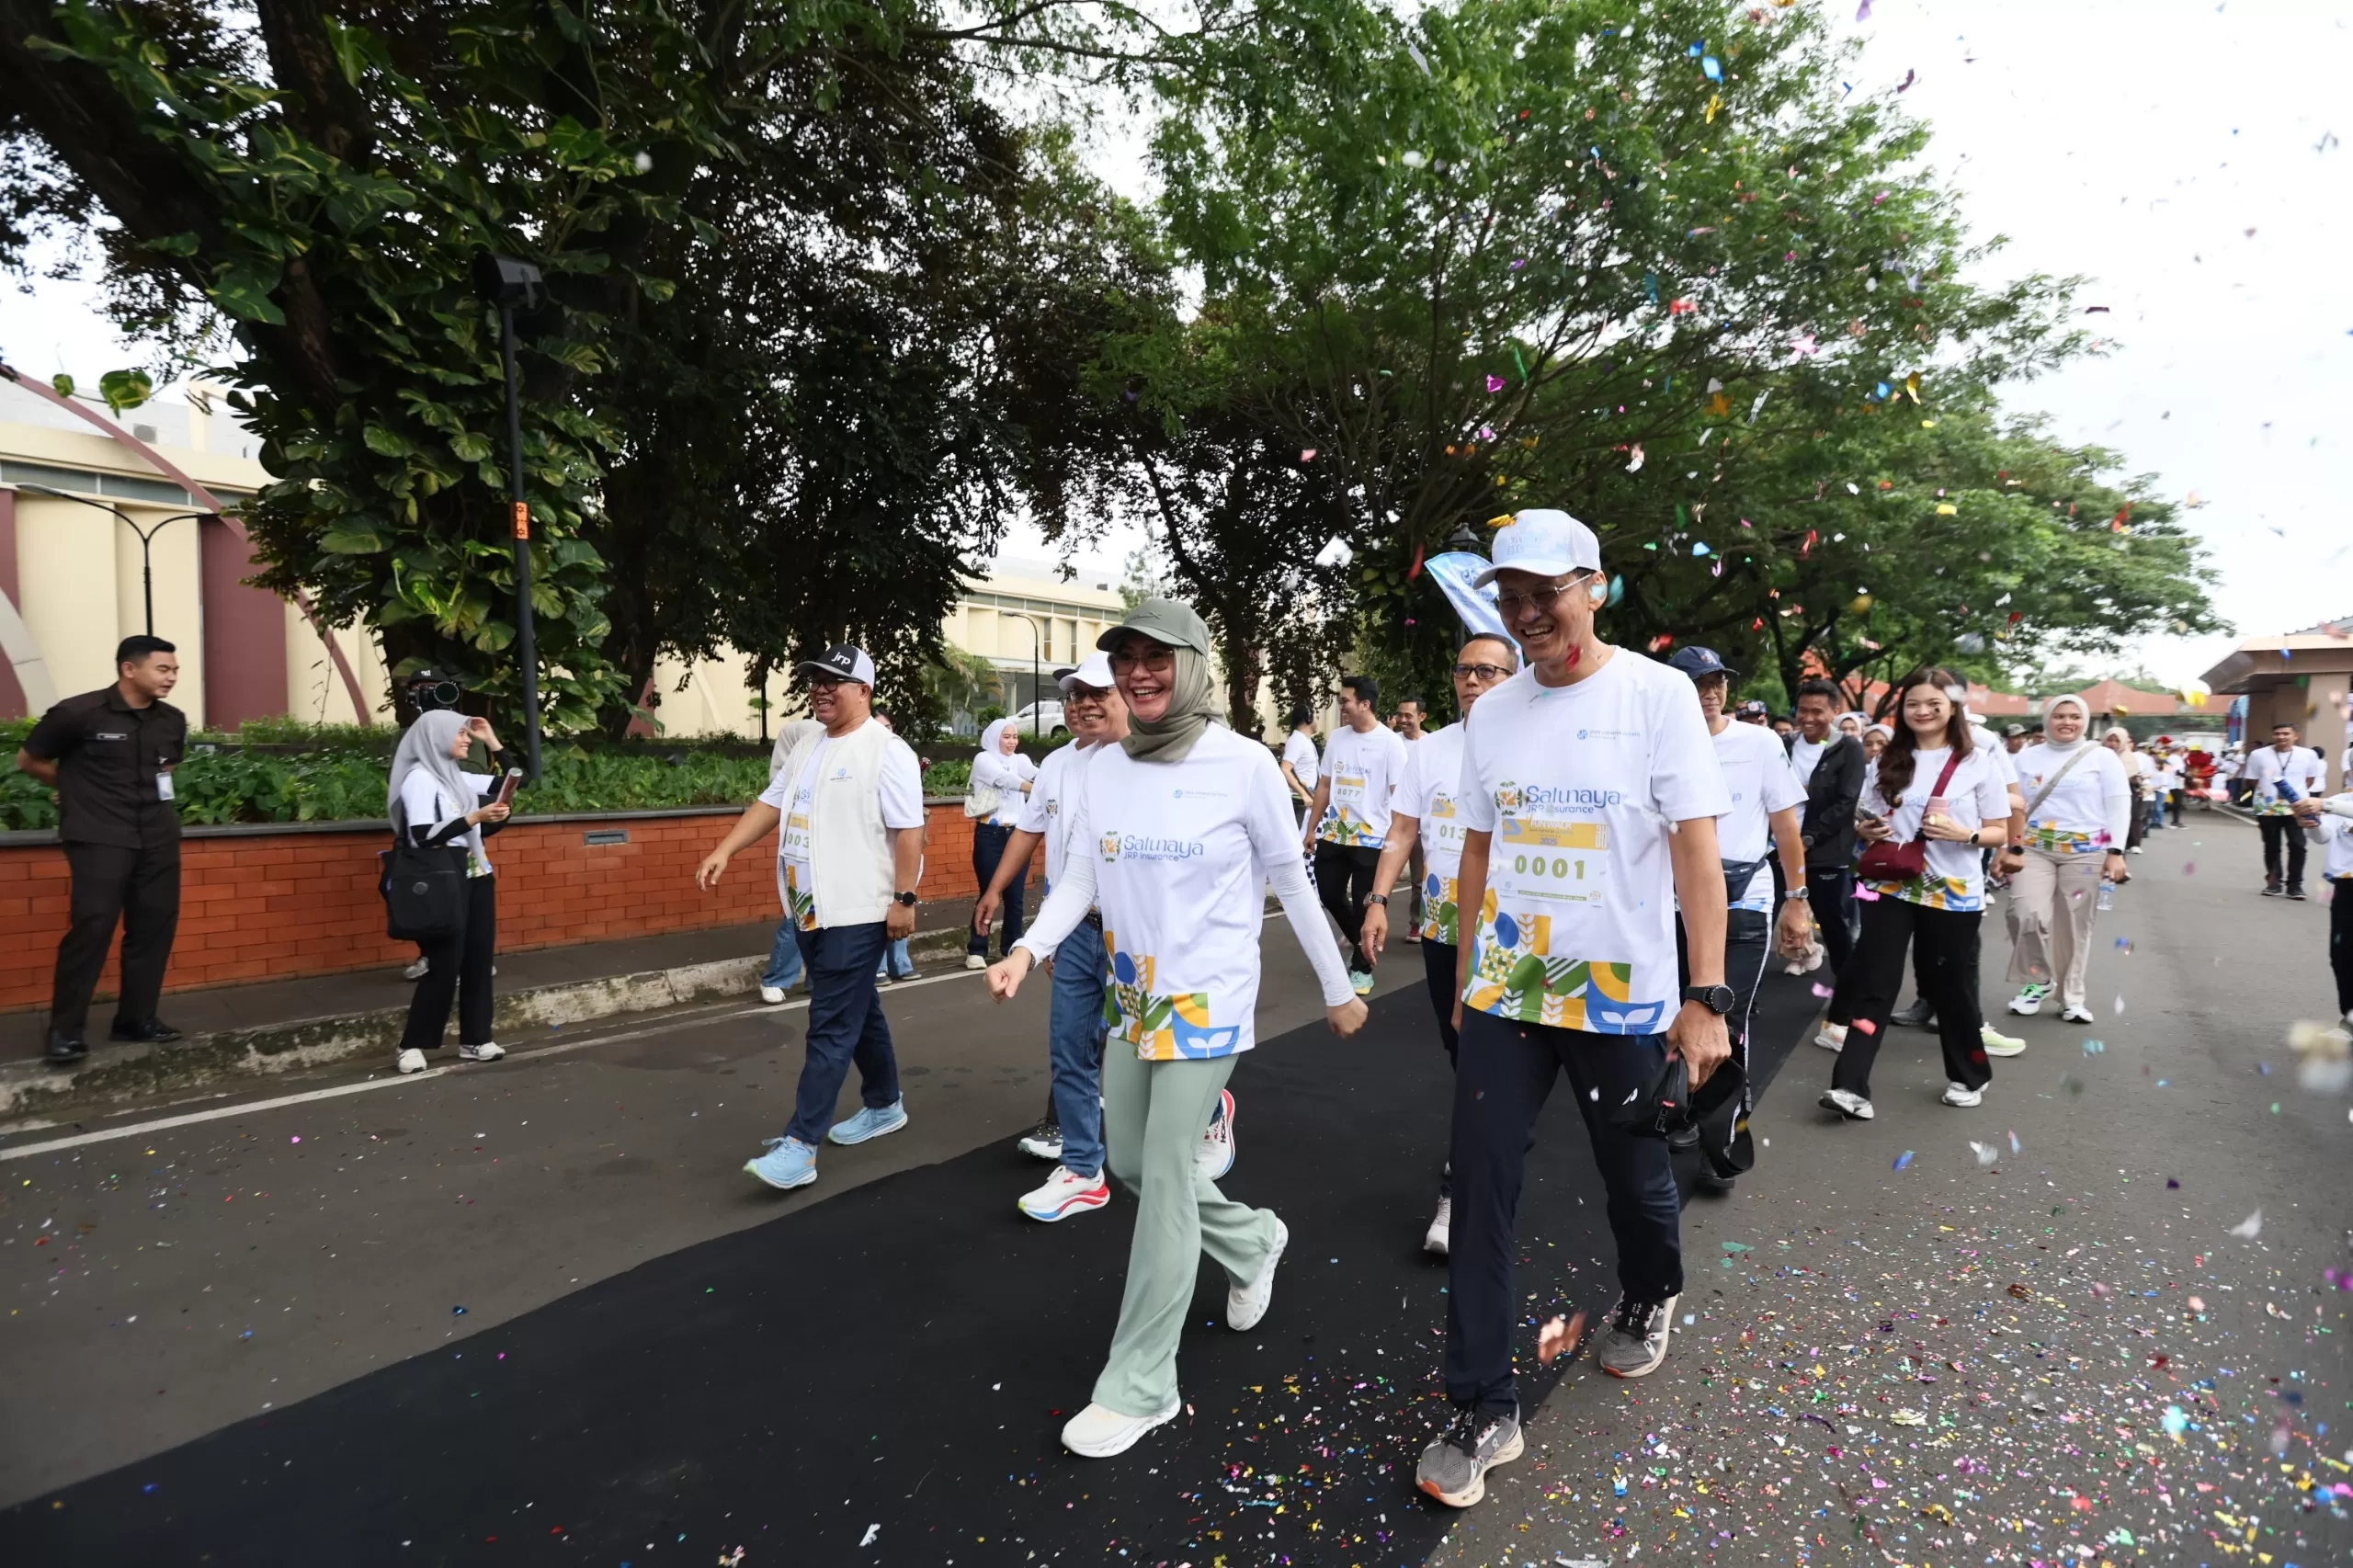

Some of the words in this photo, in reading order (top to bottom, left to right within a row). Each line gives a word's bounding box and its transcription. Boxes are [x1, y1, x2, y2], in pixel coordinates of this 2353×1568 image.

[831, 652, 851, 665] jrp
[1123, 851, 1139, 860] JRP
[1140, 853, 1179, 862] Insurance
[1514, 855, 1585, 880] 0001
